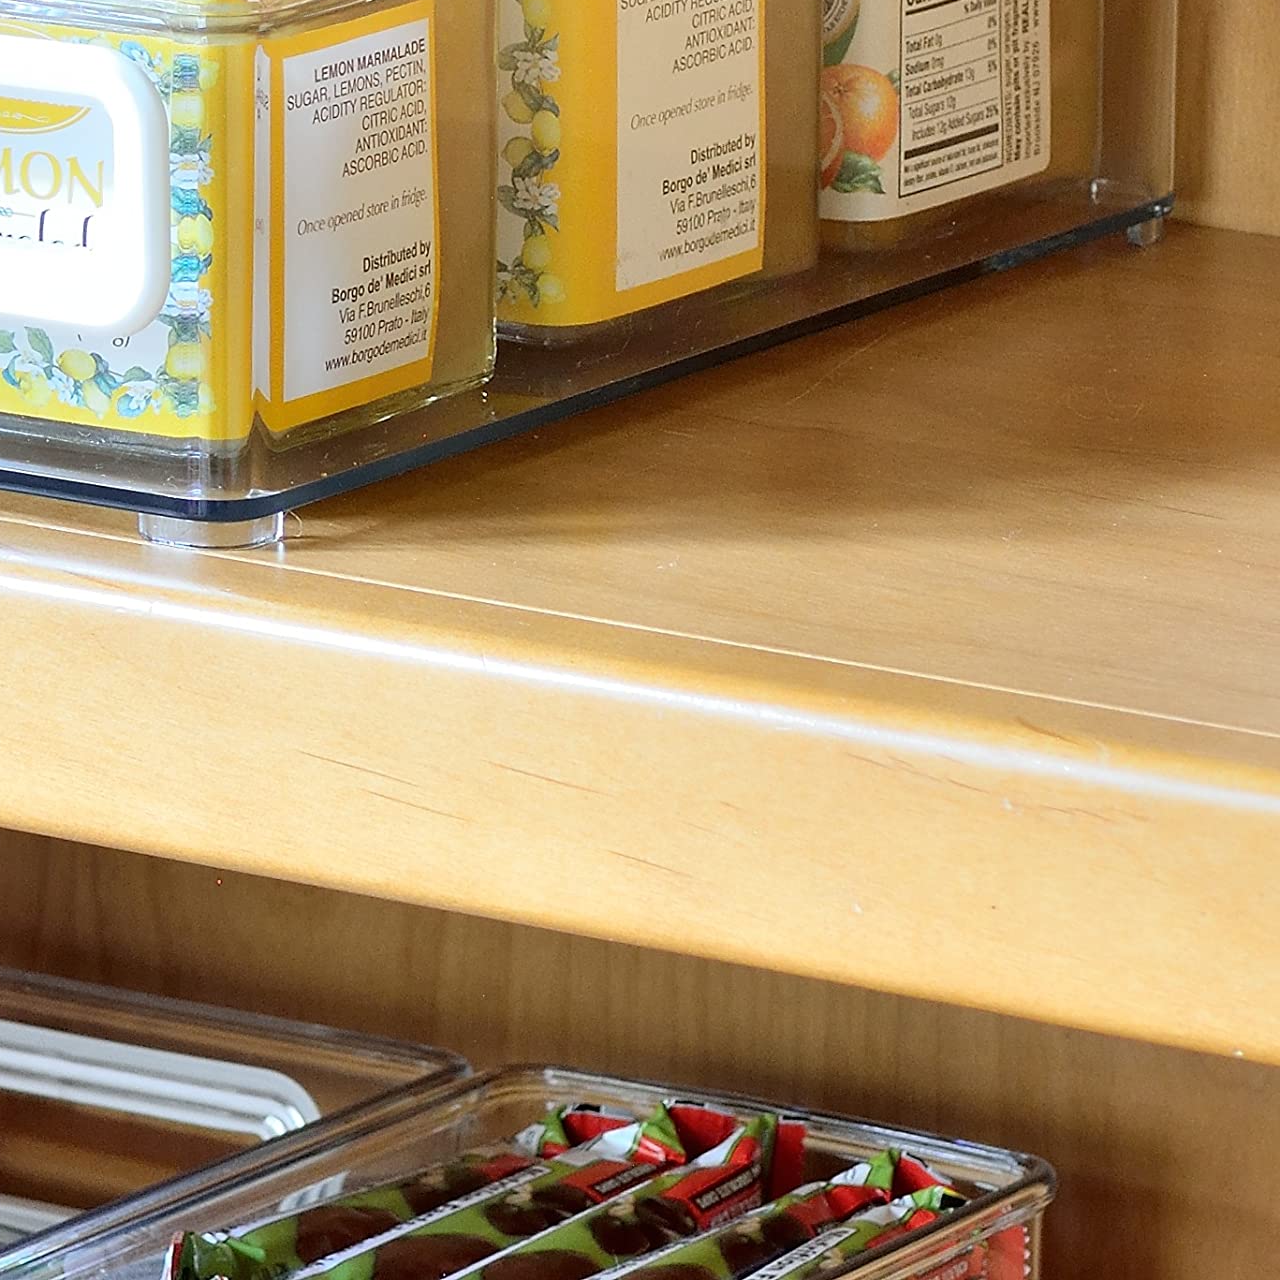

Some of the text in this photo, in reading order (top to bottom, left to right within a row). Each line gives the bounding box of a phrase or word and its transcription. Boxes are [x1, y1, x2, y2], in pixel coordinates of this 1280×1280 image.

[685, 17, 755, 50] ANTIOXIDANT:
[692, 7, 727, 29] CITRIC
[314, 38, 425, 83] LEMON MARMALADE
[672, 44, 727, 73] ASCORBIC
[287, 58, 426, 111] SUGAR, LEMONS, PECTIN,
[312, 78, 427, 125] ACIDITY REGULATOR:
[361, 99, 427, 131] CITRIC ACID,
[631, 114, 656, 131] Once
[658, 98, 693, 126] opened
[694, 94, 715, 113] store
[716, 89, 726, 105] in
[355, 118, 428, 154] ANTIOXIDANT:
[690, 132, 756, 165] Distributed by
[342, 139, 428, 178] ASCORBIC ACID.
[662, 175, 693, 196] Borgo
[712, 156, 743, 180] Medici
[744, 151, 756, 169] srl
[297, 219, 326, 236] Once
[328, 203, 365, 231] opened
[366, 201, 388, 218] store
[390, 194, 400, 209] in
[670, 199, 686, 215] Via
[676, 212, 705, 235] 59100
[363, 239, 431, 273] Distributed by
[331, 259, 431, 304] Borgo de' Medici srl
[339, 307, 356, 324] Via
[344, 322, 375, 345] 59100
[377, 316, 403, 335] Prato
[410, 308, 430, 328] Italy
